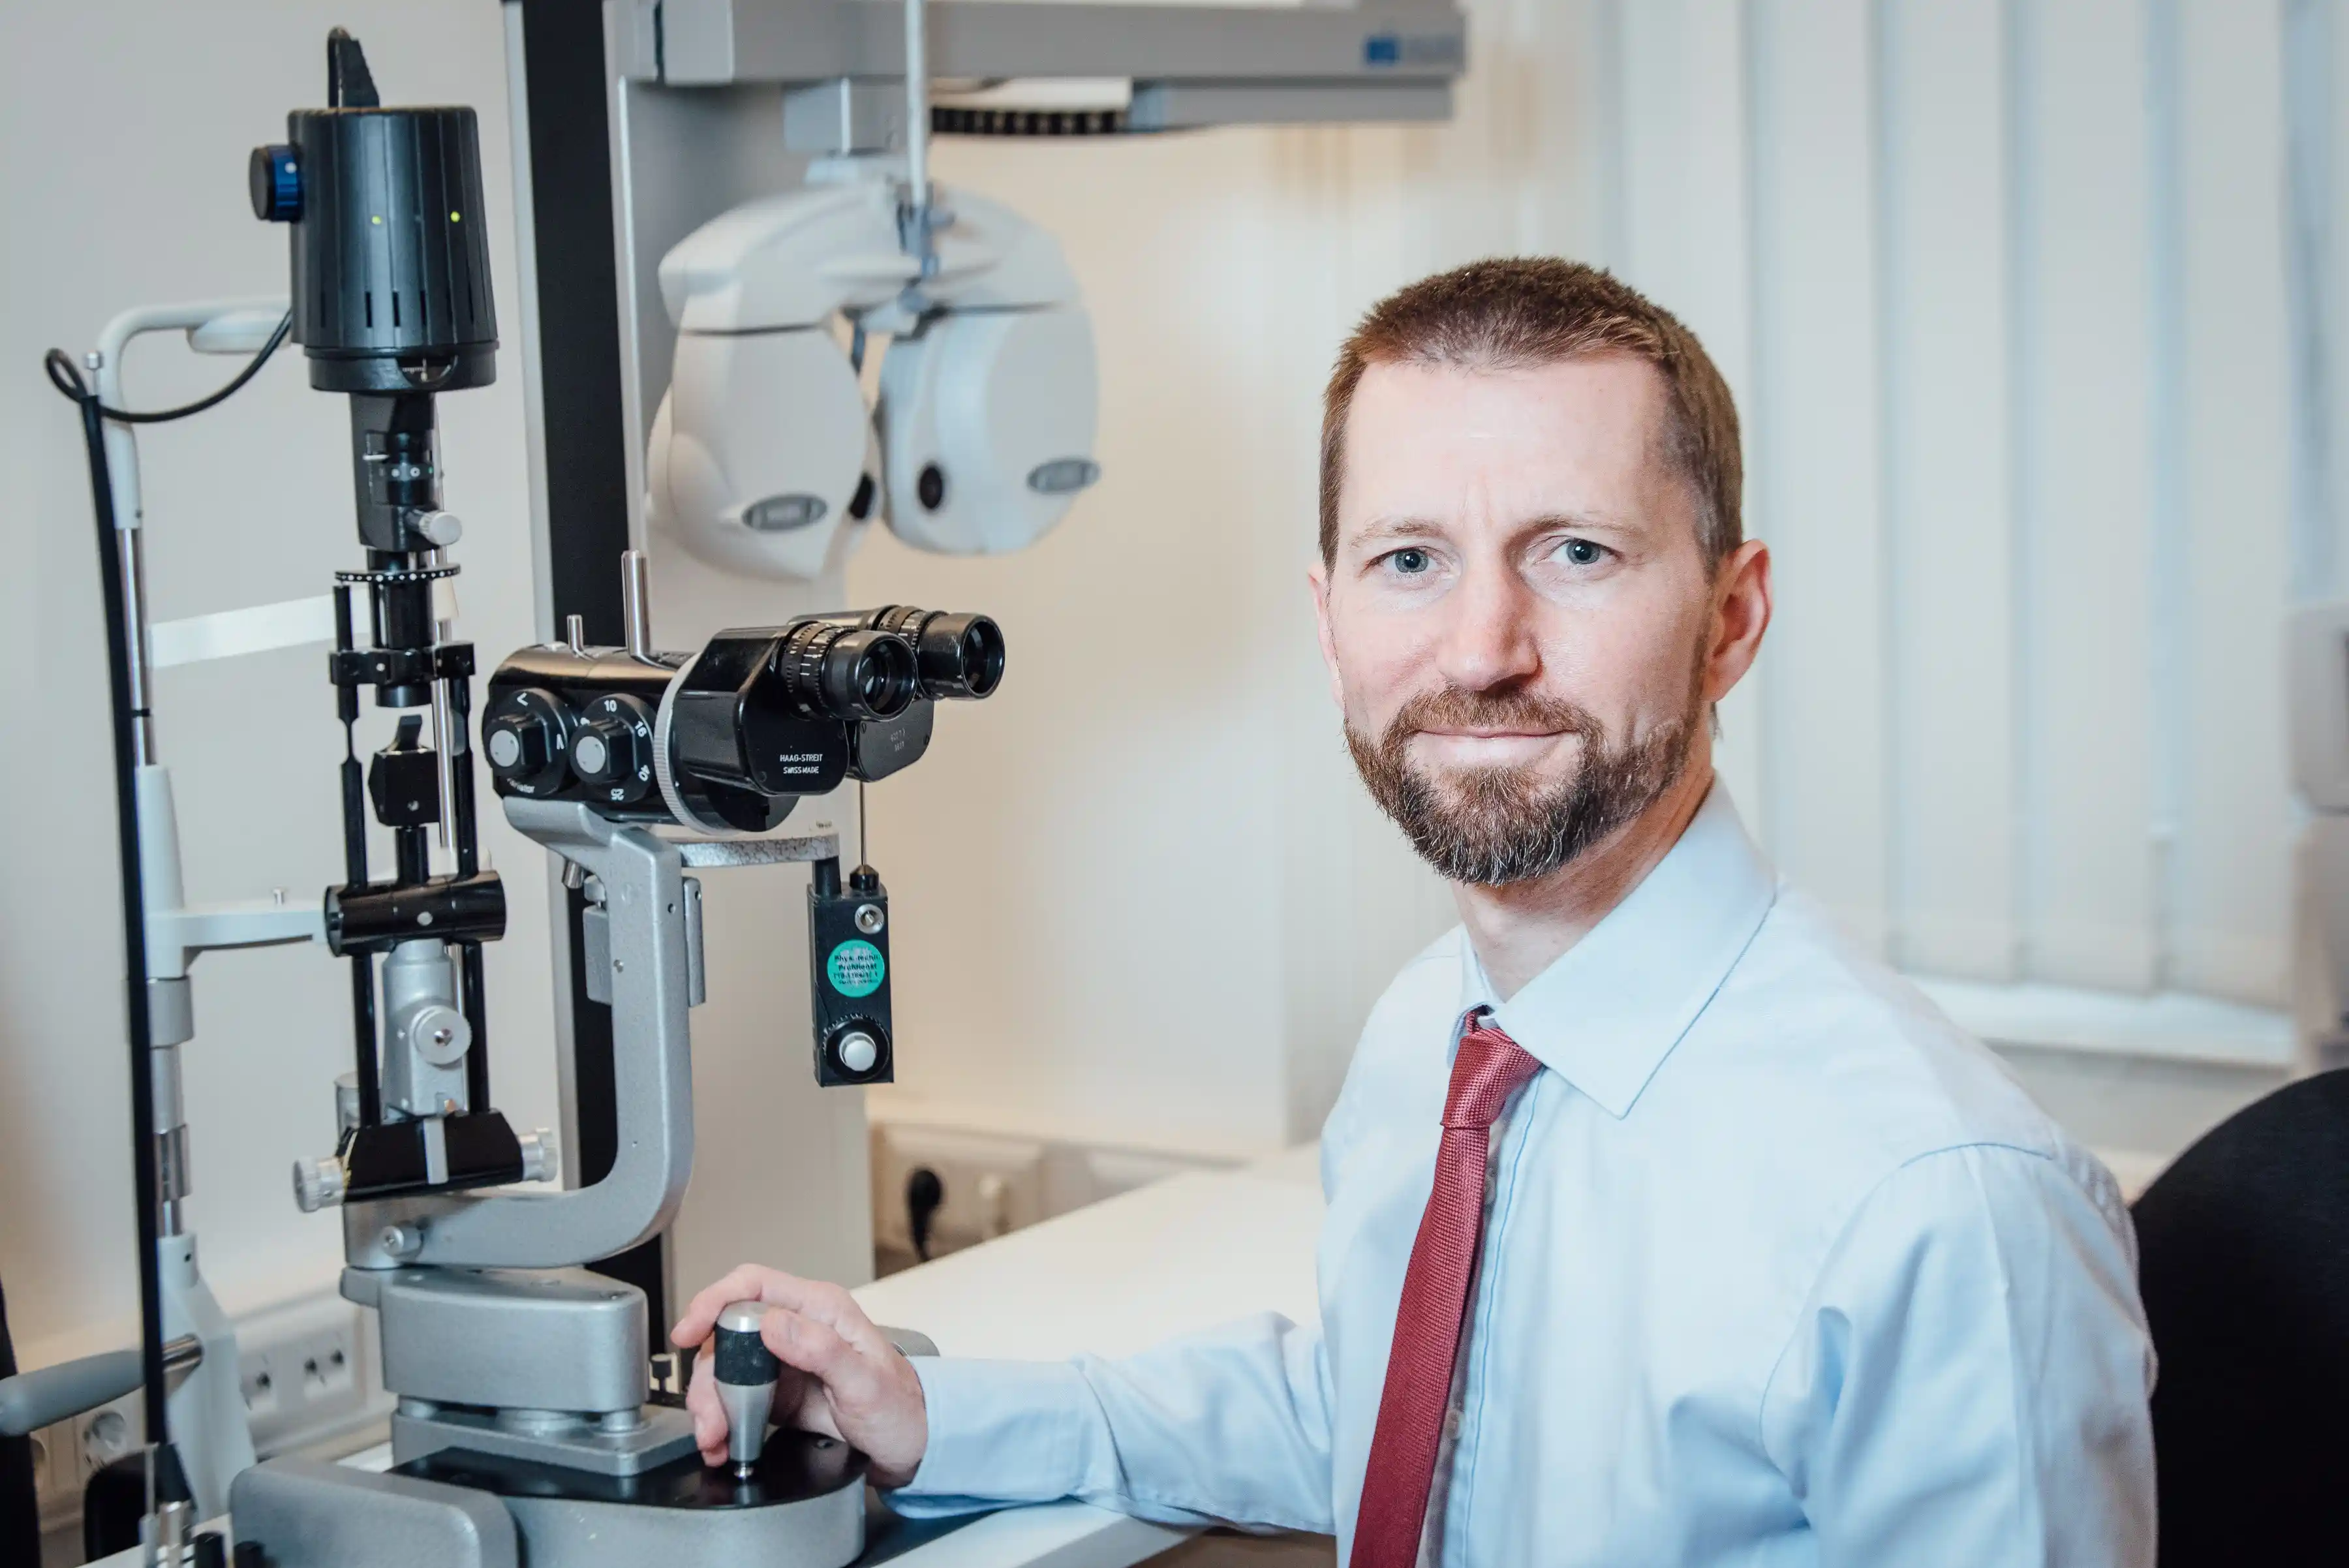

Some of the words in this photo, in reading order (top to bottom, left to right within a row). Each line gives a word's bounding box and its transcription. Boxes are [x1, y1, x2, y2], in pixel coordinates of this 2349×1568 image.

[604, 699, 617, 712] 10
[634, 720, 647, 737] 16
[780, 753, 823, 762] HAAG-STREIT
[638, 764, 650, 782] 40
[783, 766, 801, 775] SWISS
[611, 788, 624, 801] 25
